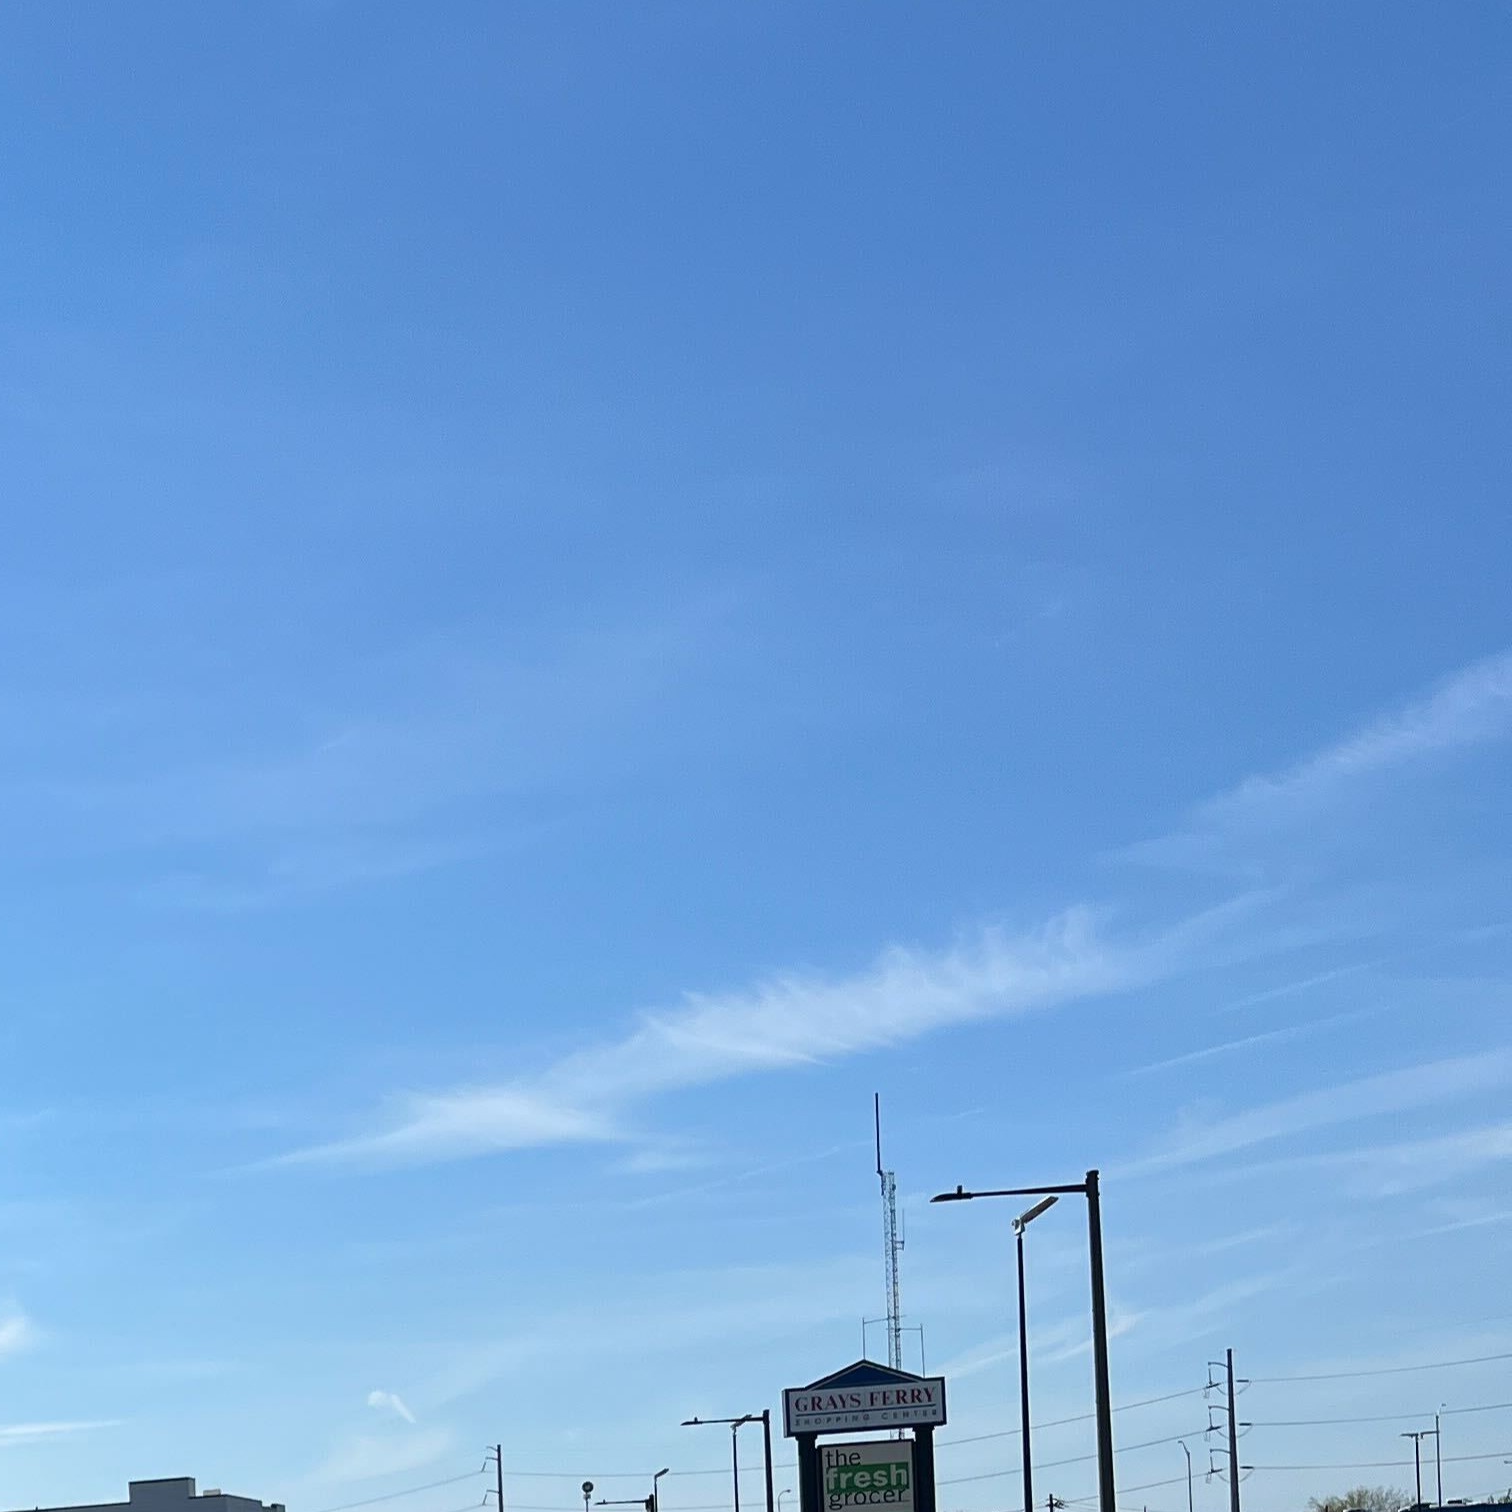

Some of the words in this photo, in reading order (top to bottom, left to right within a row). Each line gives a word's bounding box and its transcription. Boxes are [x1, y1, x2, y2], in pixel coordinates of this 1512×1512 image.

[795, 1392, 861, 1412] GRAYS
[869, 1387, 936, 1407] FERRY
[795, 1413, 870, 1427] SHOPPING
[881, 1409, 937, 1421] CENTER
[825, 1449, 861, 1468] the
[826, 1464, 908, 1490] fresh
[829, 1488, 906, 1510] grocer
